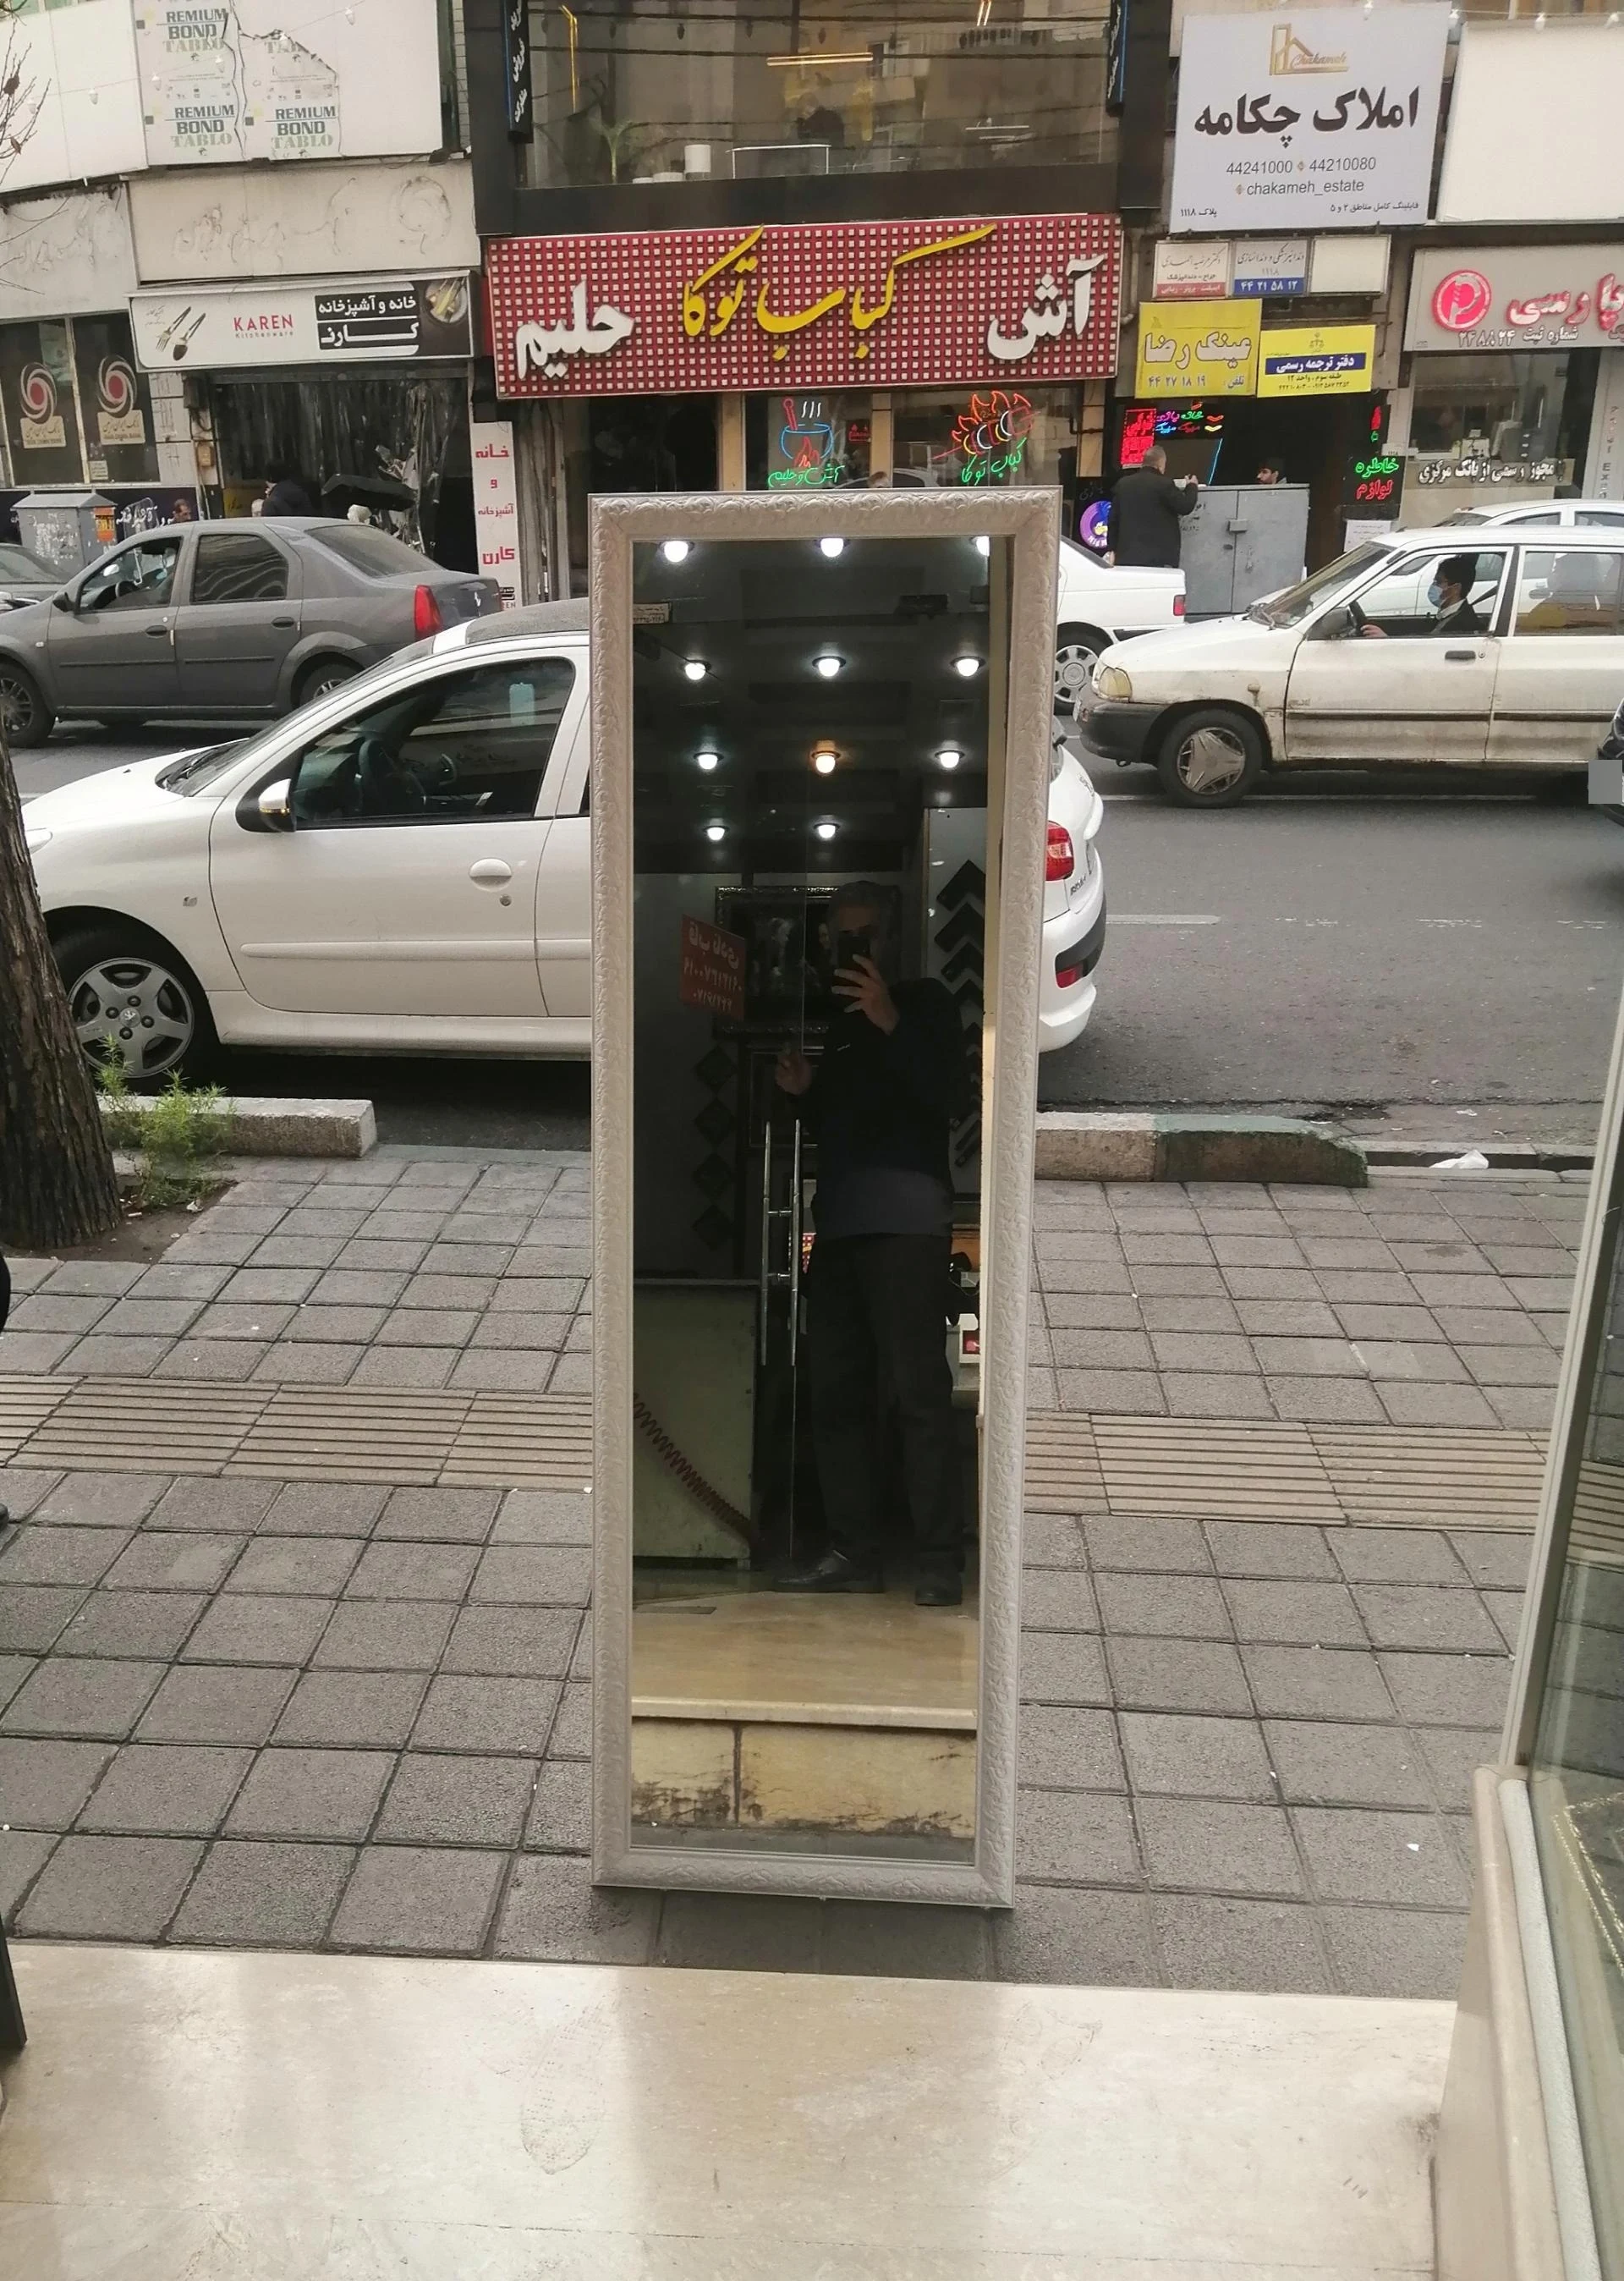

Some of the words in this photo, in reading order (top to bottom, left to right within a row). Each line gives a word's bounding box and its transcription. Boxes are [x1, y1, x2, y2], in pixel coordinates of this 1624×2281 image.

[168, 24, 217, 39] BOND
[174, 104, 235, 118] REMIUM
[275, 105, 337, 120] REMIUM
[1313, 85, 1419, 132] املاک
[177, 119, 225, 135] BOND
[277, 120, 326, 136] BOND
[1193, 92, 1302, 149] چکامه
[170, 133, 233, 148] TABLO
[271, 133, 334, 150] TABLO
[1226, 160, 1293, 175] 44241000
[1309, 157, 1377, 172] 44210080
[1246, 179, 1365, 196] chakameh_estate
[681, 224, 765, 338] توکا
[755, 223, 997, 361] کباب
[317, 297, 376, 318] آشپزخانه
[378, 301, 386, 311] و
[388, 296, 417, 311] خانه
[987, 254, 1107, 361] آش
[233, 314, 295, 332] KAREN
[514, 279, 635, 381] حلیم
[1522, 326, 1544, 344] ثبت
[1547, 325, 1579, 344] شماره
[1144, 331, 1191, 370] رضا
[1194, 331, 1253, 369] عینک
[1276, 361, 1304, 374] رسمی
[1305, 355, 1334, 371] ترجمه
[1334, 354, 1355, 371] دفتر
[1149, 376, 1161, 387] ۴۴
[1182, 376, 1192, 387] ۱۸
[475, 442, 510, 459] خانه
[990, 437, 1027, 478] کباب
[961, 453, 986, 486] توکا
[1355, 457, 1399, 480] خاطره
[1418, 459, 1452, 485] مرکزی
[1455, 459, 1479, 481] بانک
[1480, 459, 1490, 482] از
[490, 478, 498, 489] و
[1356, 479, 1393, 501] لوازم
[477, 503, 514, 519] آشپزخانه
[482, 546, 515, 565] کارن
